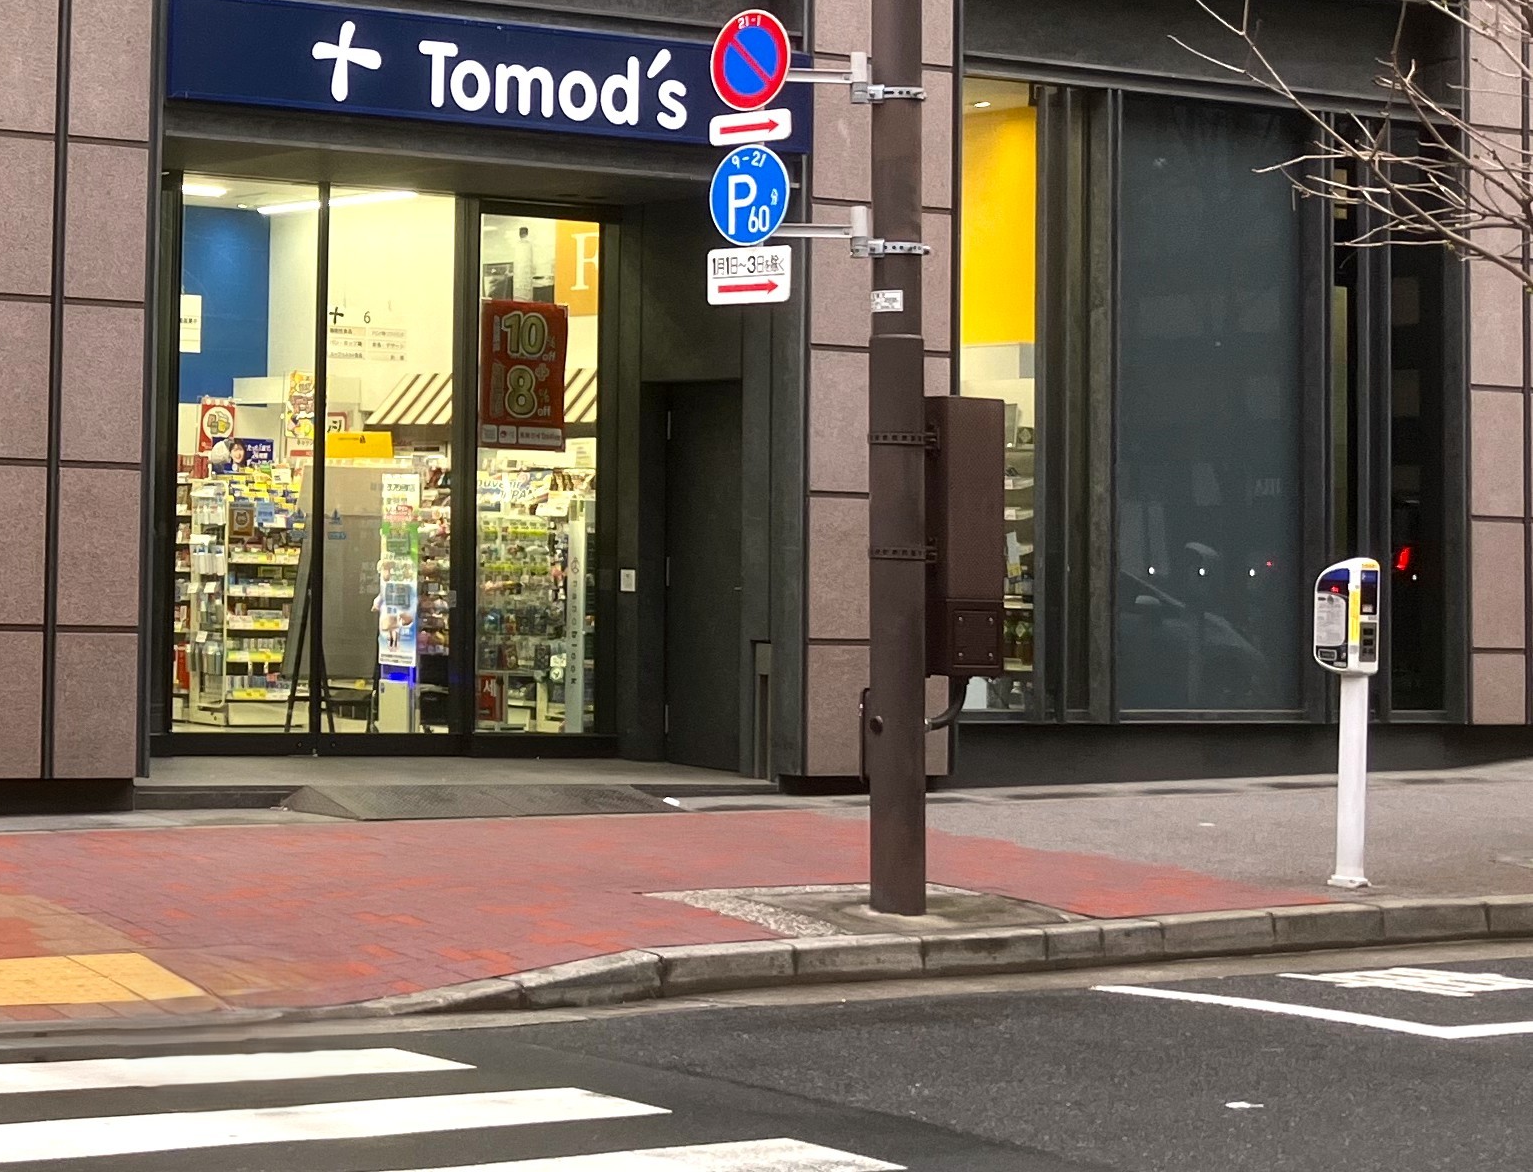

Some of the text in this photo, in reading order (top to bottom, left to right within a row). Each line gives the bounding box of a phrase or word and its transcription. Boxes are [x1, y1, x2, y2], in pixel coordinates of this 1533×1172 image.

[737, 15, 762, 30] 21-1
[418, 40, 688, 130] Tomod's
[732, 152, 766, 169] 9-21
[728, 174, 758, 236] P
[770, 188, 779, 206] 分
[748, 205, 771, 233] 60
[363, 311, 371, 324] 6
[537, 405, 551, 417] off
